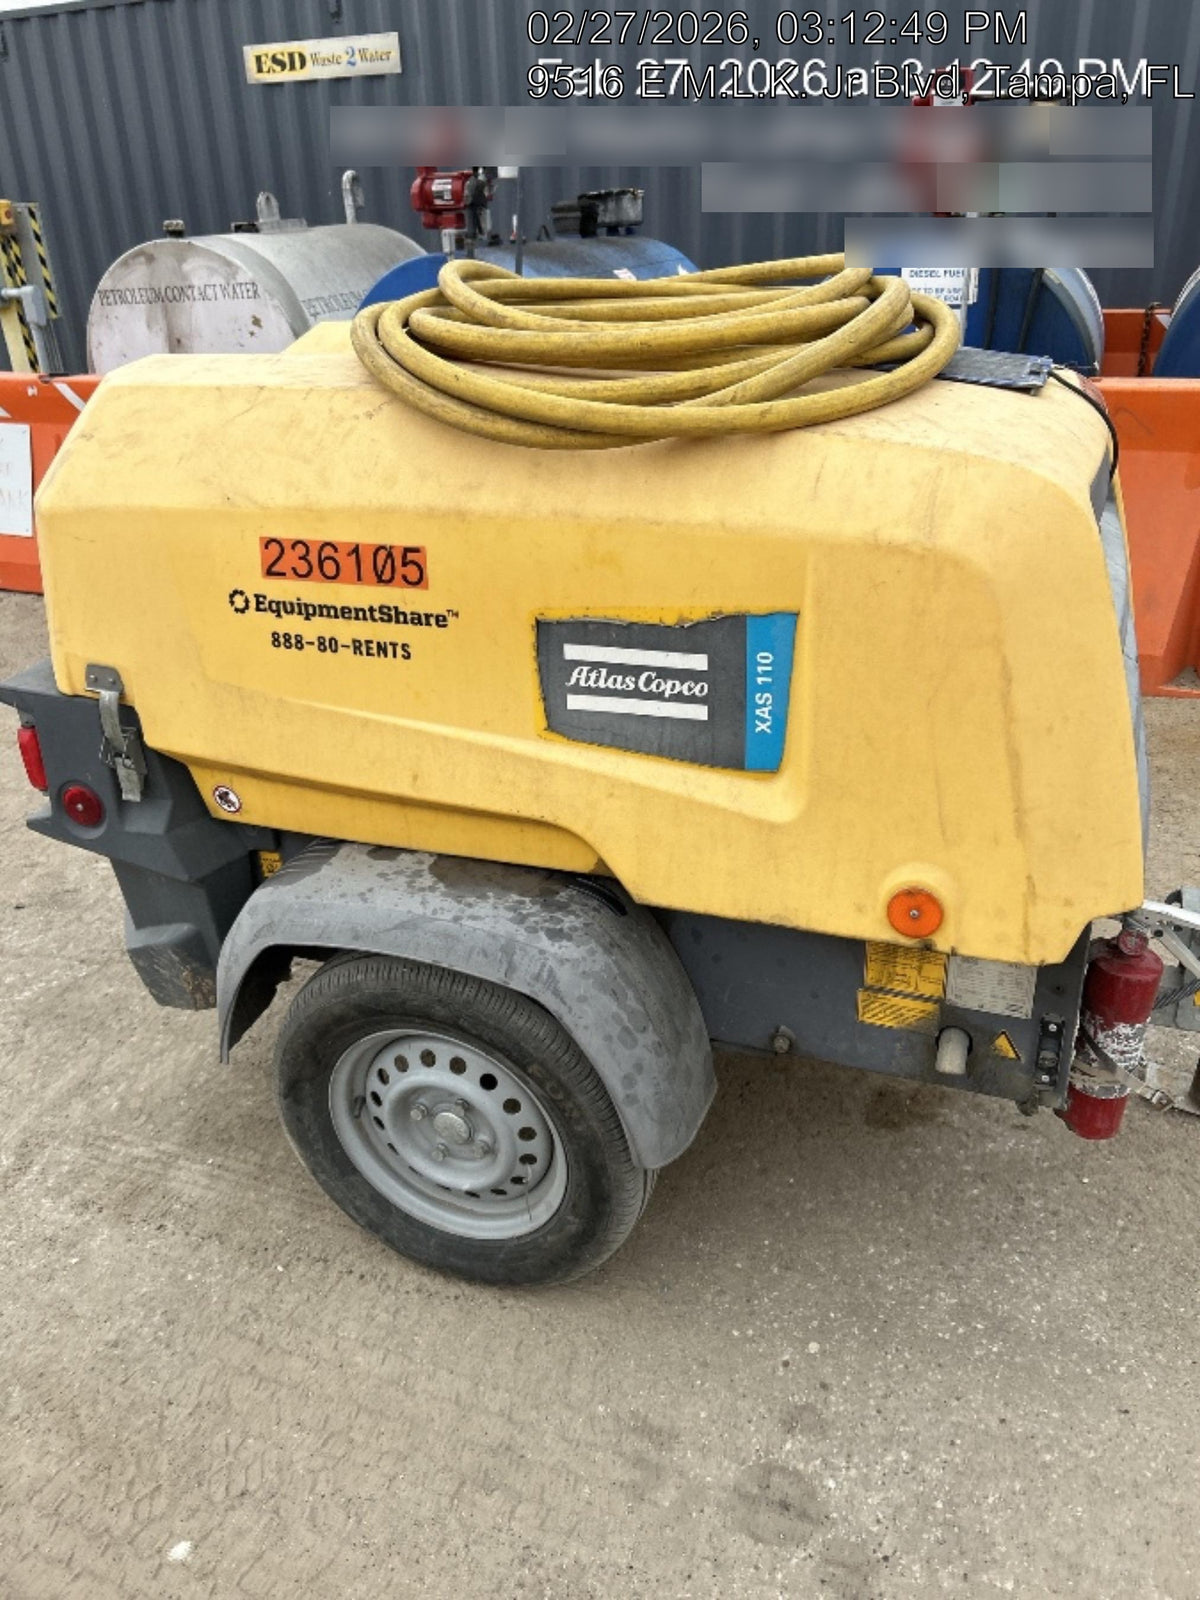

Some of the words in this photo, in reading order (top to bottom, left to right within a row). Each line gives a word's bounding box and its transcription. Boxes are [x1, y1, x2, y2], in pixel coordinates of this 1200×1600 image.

[254, 51, 307, 74] ESD
[310, 52, 342, 67] Waste
[345, 45, 357, 67] 2
[358, 47, 392, 63] Water
[98, 287, 163, 306] PETROLEUM
[164, 284, 219, 303] CONTACT
[219, 282, 261, 300] WATER
[263, 537, 425, 587] 236105
[271, 631, 412, 661] 888-80-RENTS
[565, 665, 636, 691] Atlas
[637, 671, 709, 698] Copco
[756, 650, 775, 684] 110
[755, 691, 773, 734] XAS
